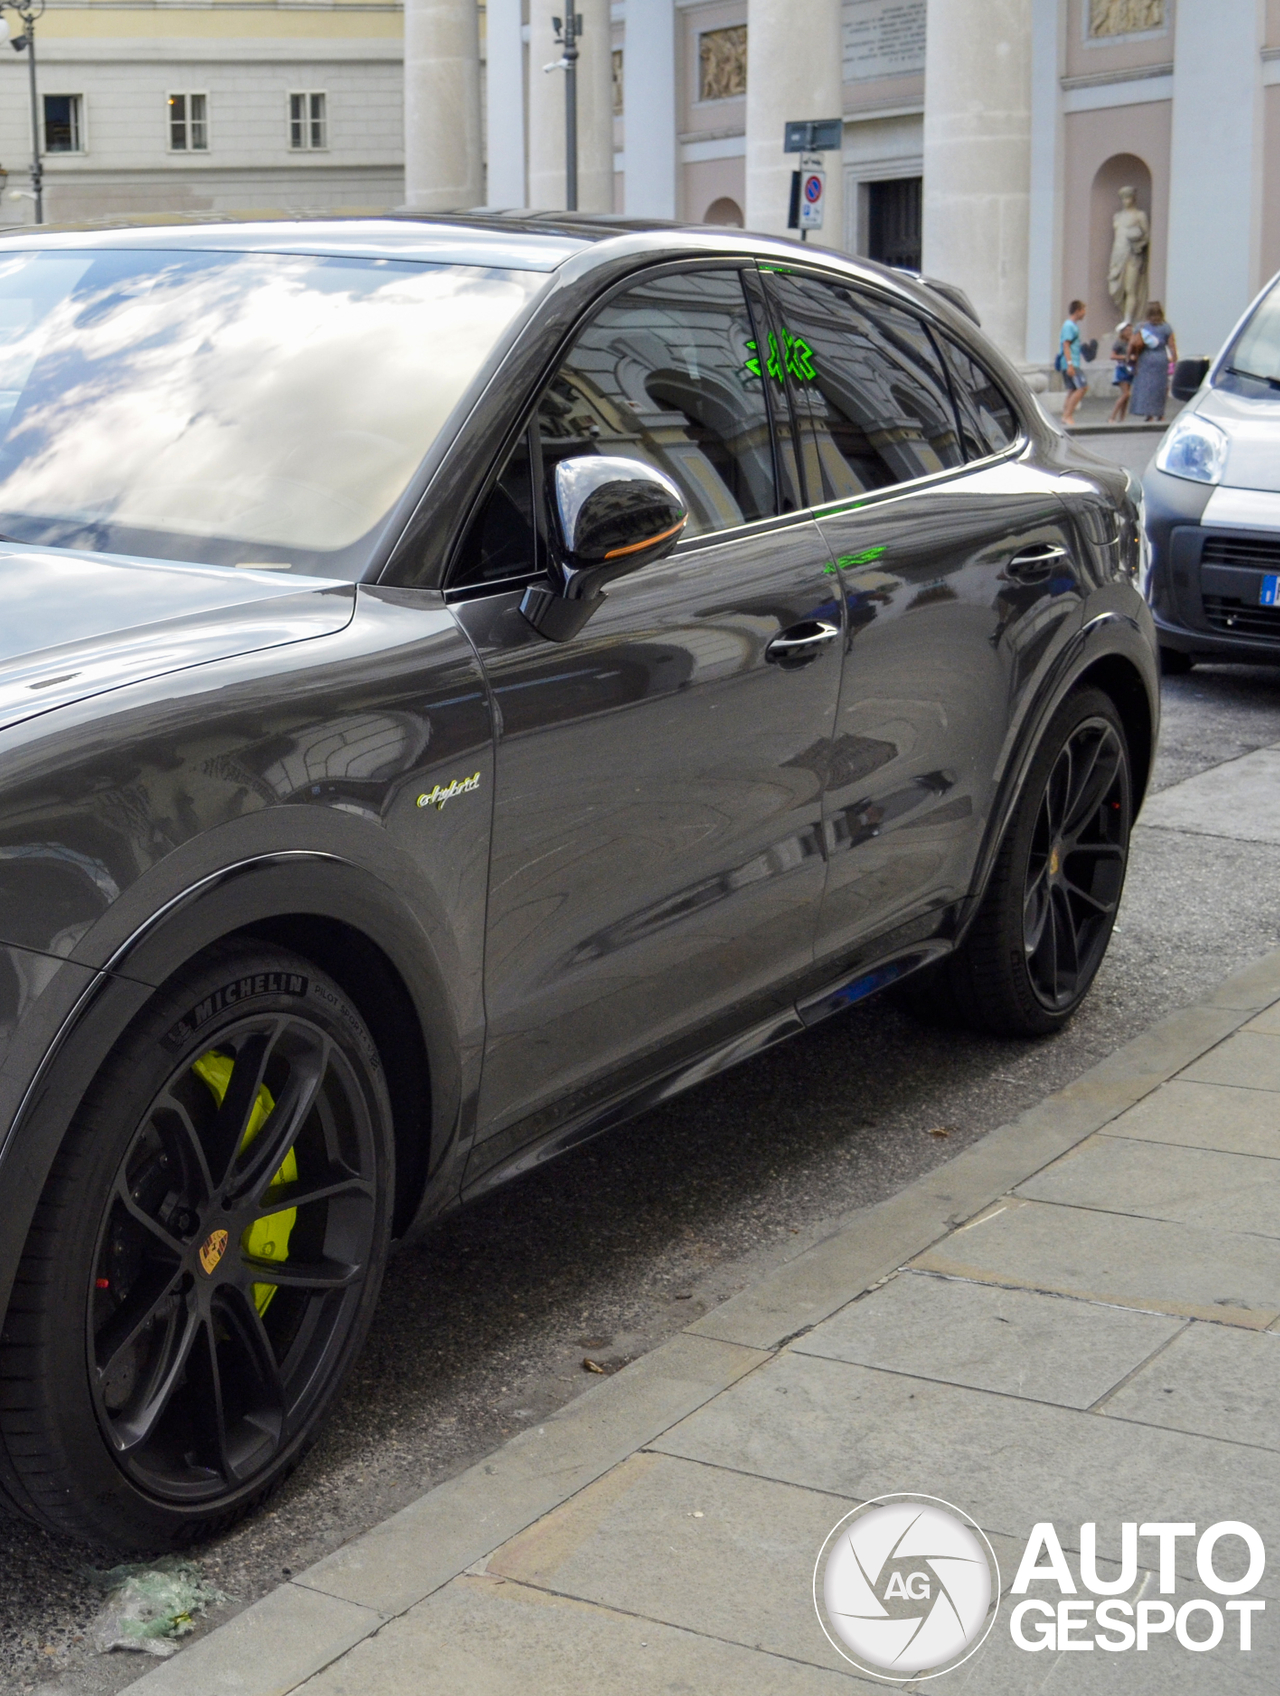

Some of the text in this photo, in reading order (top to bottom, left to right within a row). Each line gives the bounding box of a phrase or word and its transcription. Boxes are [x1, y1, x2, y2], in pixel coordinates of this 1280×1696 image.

[194, 974, 363, 1036] MICHELIN PILOT SPORT
